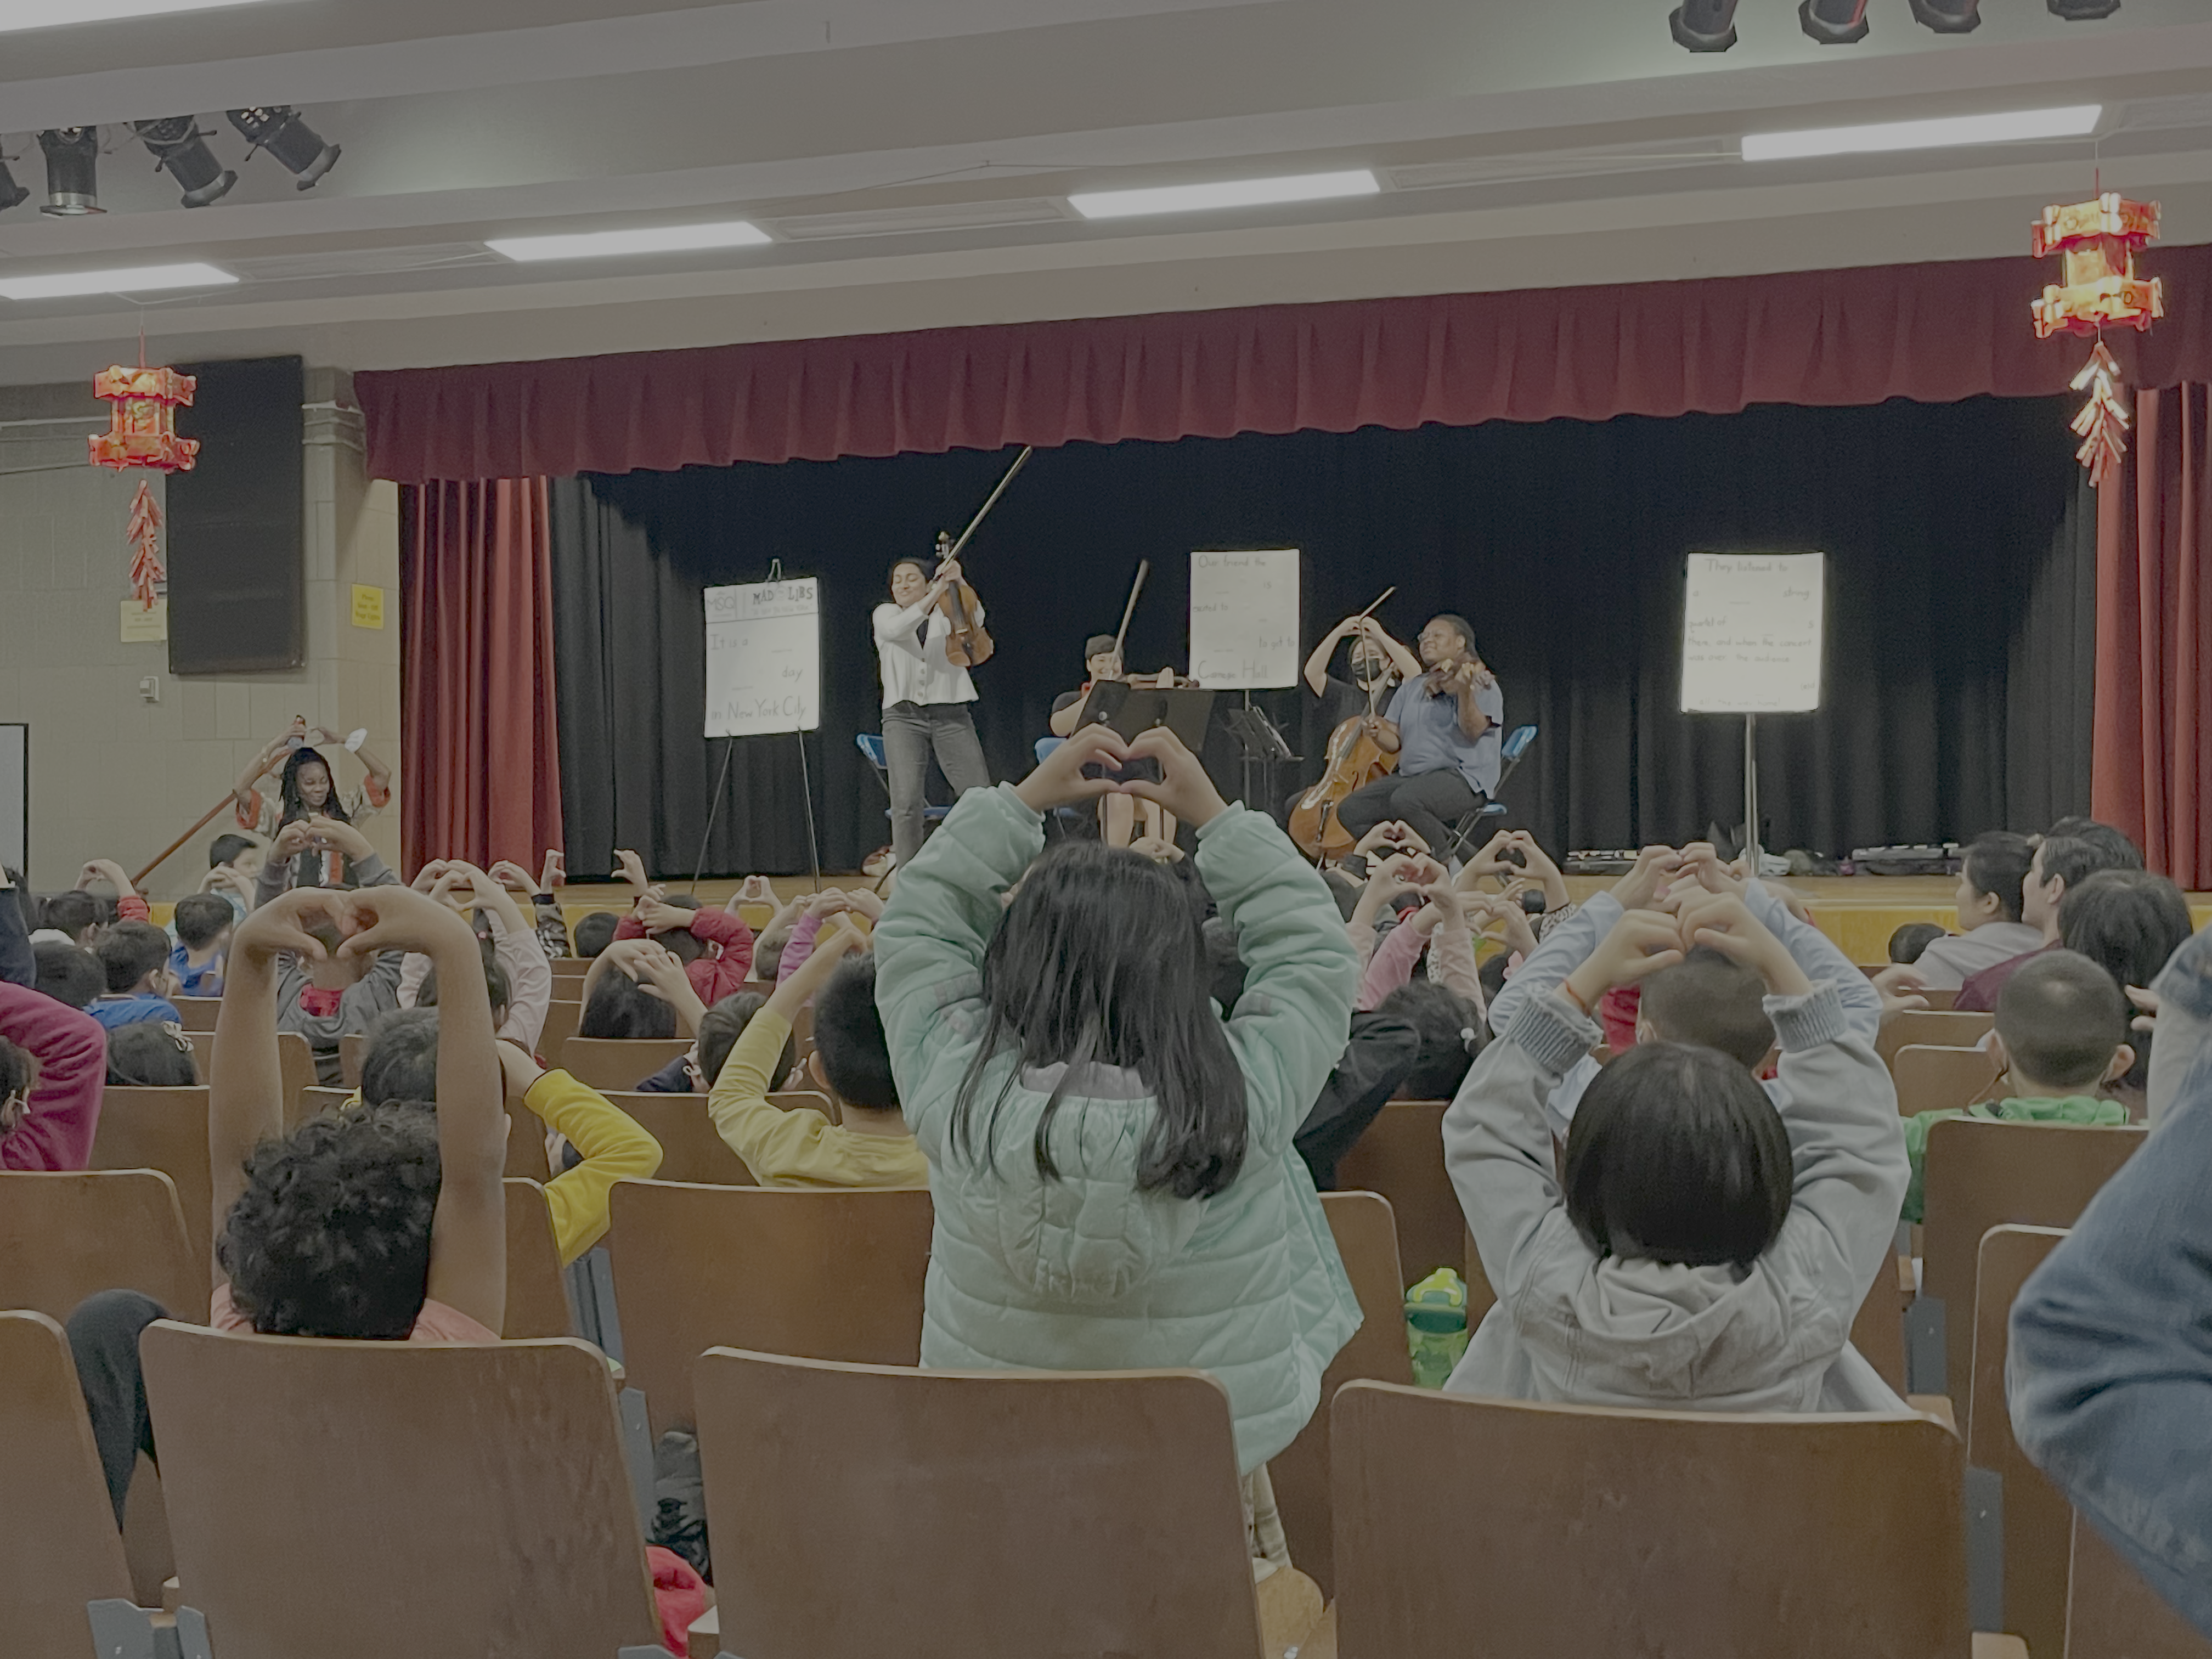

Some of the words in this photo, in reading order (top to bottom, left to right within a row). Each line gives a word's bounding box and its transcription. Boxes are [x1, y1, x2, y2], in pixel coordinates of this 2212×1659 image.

[1198, 554, 1218, 568] Our
[1223, 554, 1249, 567] friend
[1254, 557, 1266, 567] the
[1704, 558, 1732, 574] They
[1737, 560, 1771, 572] listened
[1779, 562, 1788, 572] to
[1263, 580, 1272, 589] is
[753, 589, 774, 605] MAD
[787, 586, 813, 602] LIBS
[1782, 586, 1809, 601] string
[1221, 602, 1228, 611] to
[1717, 615, 1727, 626] of
[710, 634, 725, 650] It
[729, 639, 737, 648] is
[742, 638, 748, 646] a
[1259, 635, 1268, 648] to
[1271, 636, 1283, 651] get
[1287, 636, 1295, 647] to
[1716, 635, 1731, 646] and
[1736, 636, 1757, 646] when
[1762, 637, 1774, 647] the
[1779, 638, 1812, 647] concert
[1736, 653, 1748, 662] the
[782, 665, 804, 683] day
[1242, 658, 1269, 679] Hall
[711, 710, 722, 720] in
[727, 701, 753, 720] New
[754, 698, 780, 718] York
[783, 695, 807, 722] City
[1699, 696, 1711, 706] all
